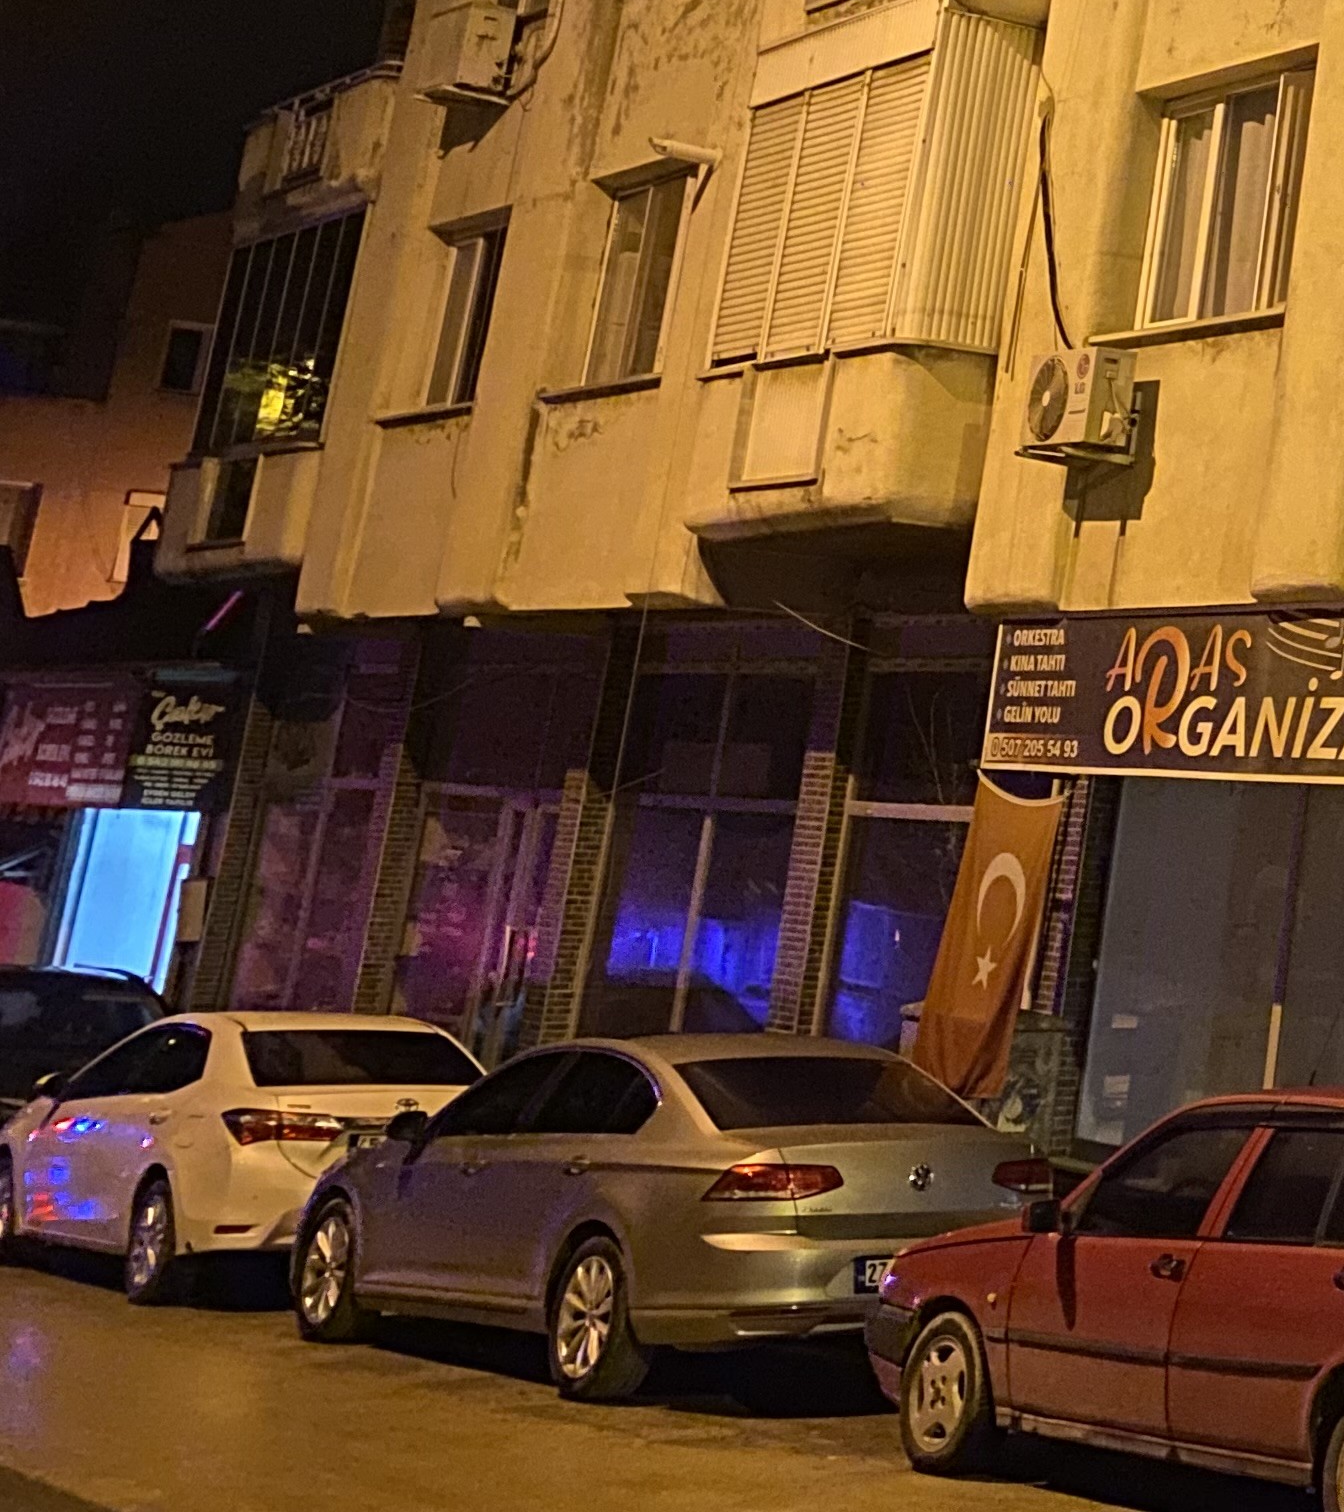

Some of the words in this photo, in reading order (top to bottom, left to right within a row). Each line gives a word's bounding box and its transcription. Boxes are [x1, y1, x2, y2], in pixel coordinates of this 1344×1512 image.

[1013, 629, 1064, 646] ORKESTRA
[1010, 655, 1034, 671] KINA
[1037, 655, 1065, 671] TAHTI
[1046, 680, 1076, 697] TAHTI
[1106, 624, 1252, 750] ARAS
[1004, 701, 1032, 723] GELİN
[1034, 706, 1061, 723] YOLU
[1001, 740, 1023, 757] 507
[1024, 740, 1044, 757] 205
[1046, 740, 1060, 757] 54
[1063, 740, 1078, 757] 93
